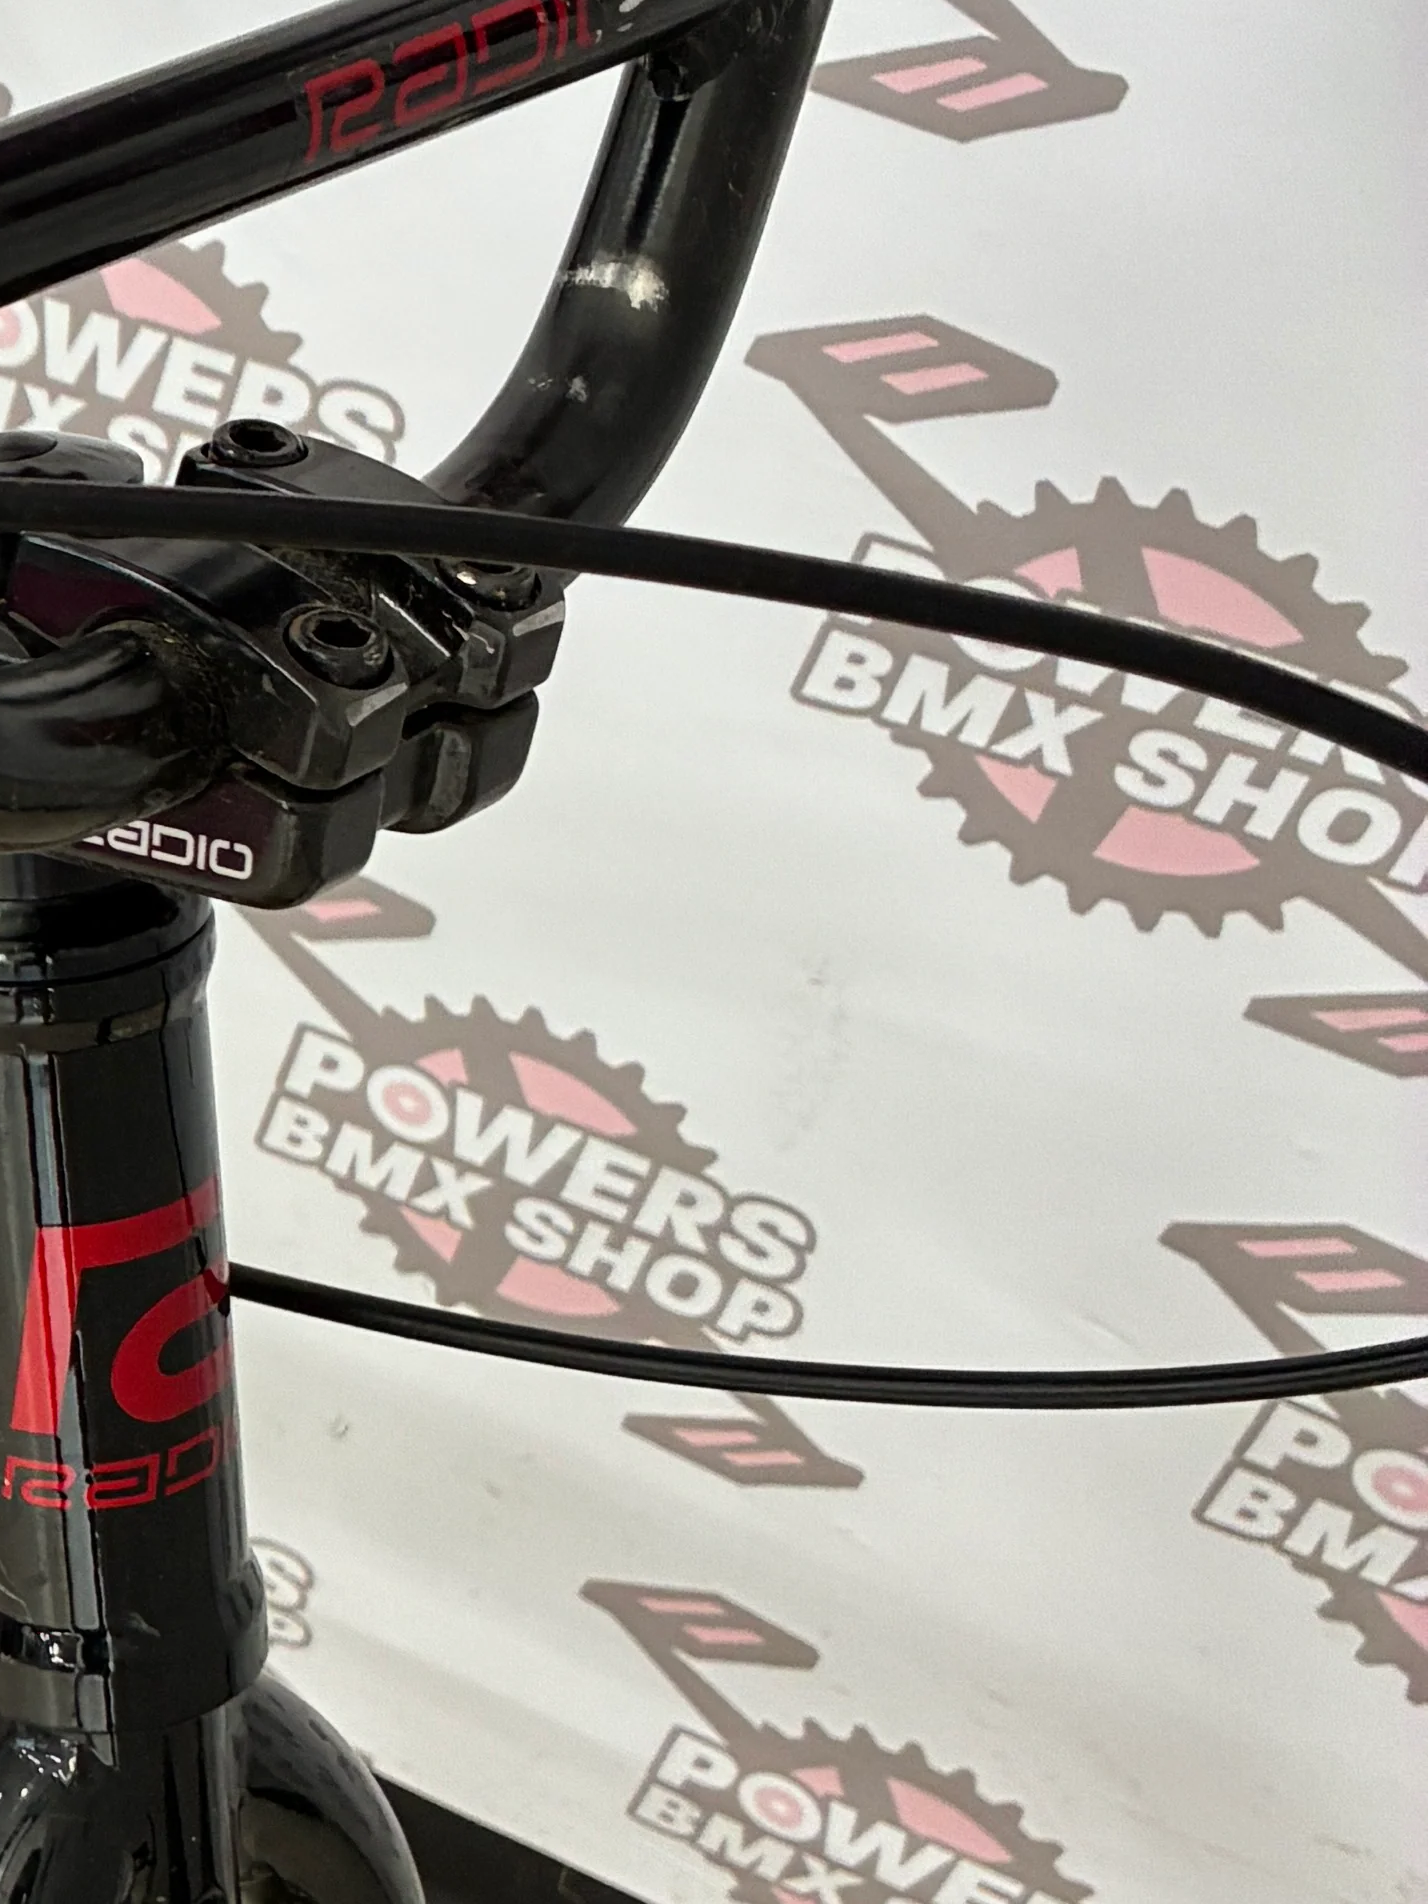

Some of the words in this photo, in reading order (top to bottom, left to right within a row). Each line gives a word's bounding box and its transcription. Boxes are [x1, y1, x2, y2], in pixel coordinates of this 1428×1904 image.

[801, 630, 1104, 776] BMX
[264, 1096, 492, 1229] BMX
[504, 1197, 796, 1339] SHOP
[283, 1030, 810, 1283] POWERS
[1201, 1466, 1428, 1602] BM
